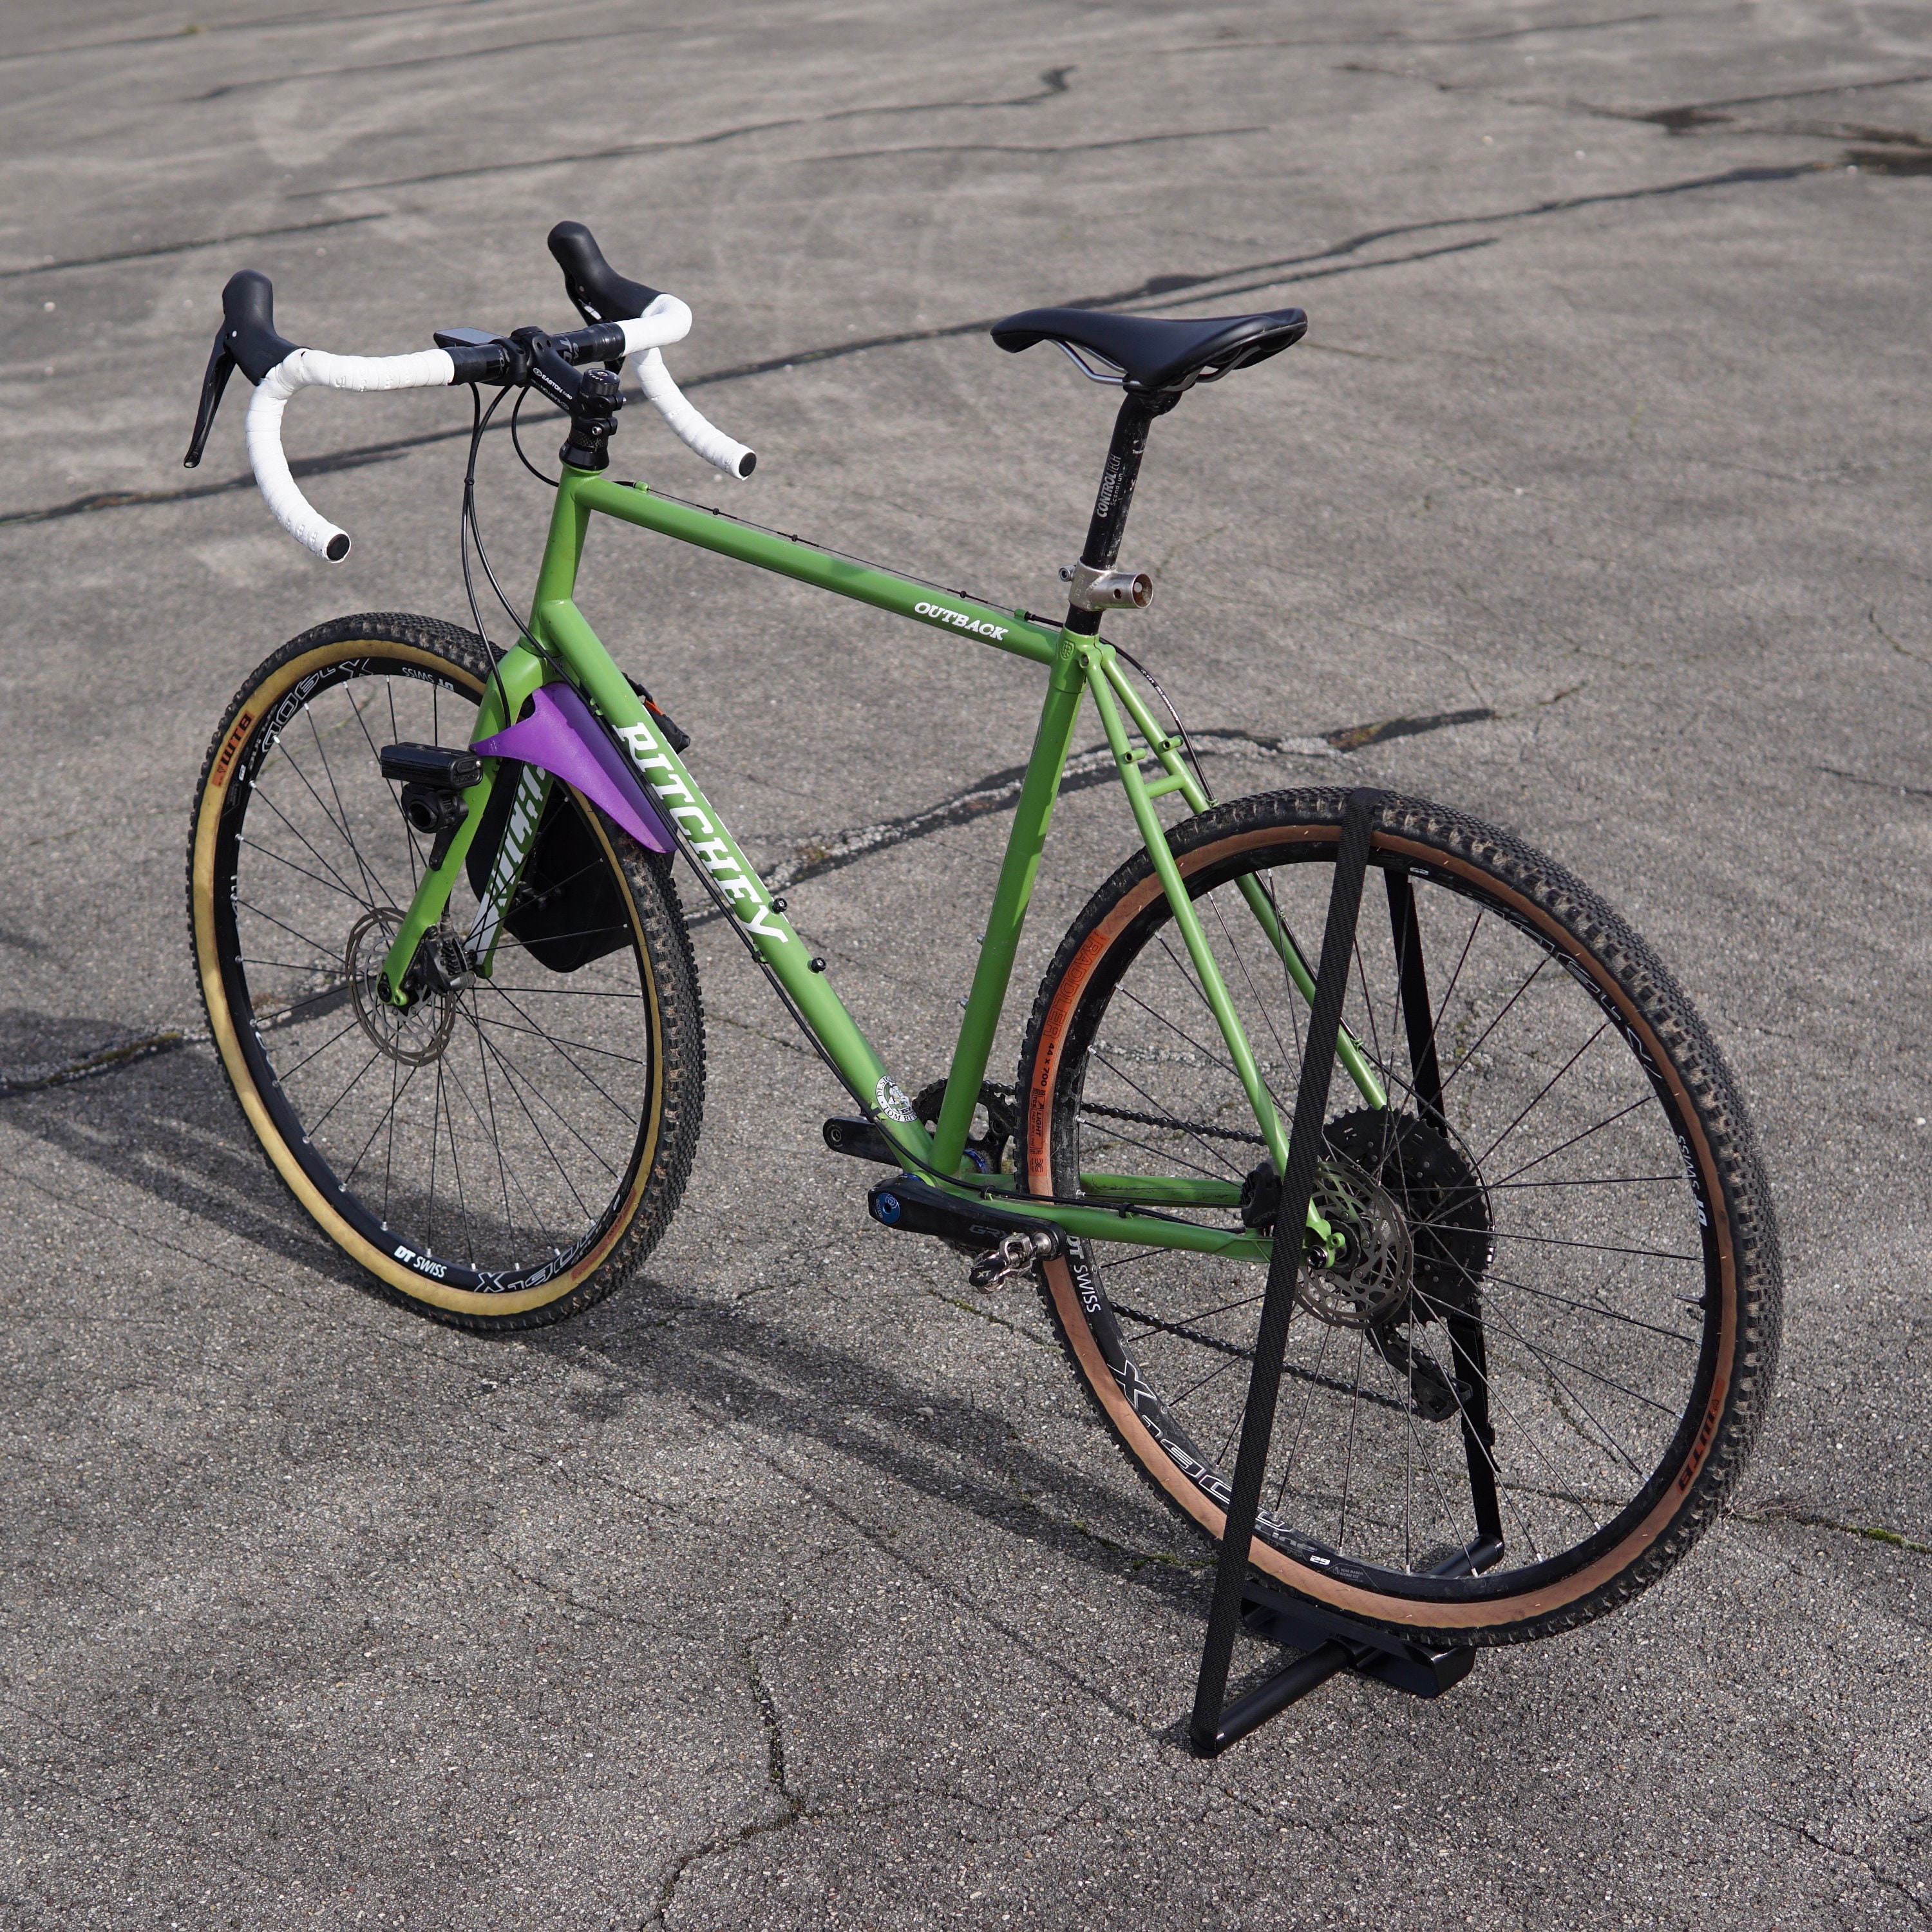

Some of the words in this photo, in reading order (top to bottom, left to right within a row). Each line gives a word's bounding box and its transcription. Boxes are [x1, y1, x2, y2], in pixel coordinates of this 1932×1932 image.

[542, 374, 564, 393] EASTON
[1096, 453, 1122, 518] CONTROLTECH
[914, 602, 1009, 640] OUTBACK
[402, 667, 433, 685] SWISS
[439, 677, 454, 692] DT
[221, 714, 252, 766] WTB
[611, 721, 789, 943] RITCHEY
[1043, 936, 1104, 1039] RADDLER
[1046, 1043, 1055, 1056] 44
[876, 1076, 892, 1097] DESIG
[1040, 1067, 1050, 1086] 700
[884, 1105, 900, 1121] TOM
[1676, 1135, 1700, 1190] SWISS
[1694, 1193, 1707, 1227] DT
[1066, 1235, 1084, 1259] DT
[393, 1245, 416, 1263] DT
[414, 1255, 448, 1278] SWISS
[976, 1269, 992, 1278] XT
[1074, 1264, 1101, 1313] SWISS
[1678, 1411, 1715, 1492] WTB
[1309, 1555, 1331, 1566] 29
